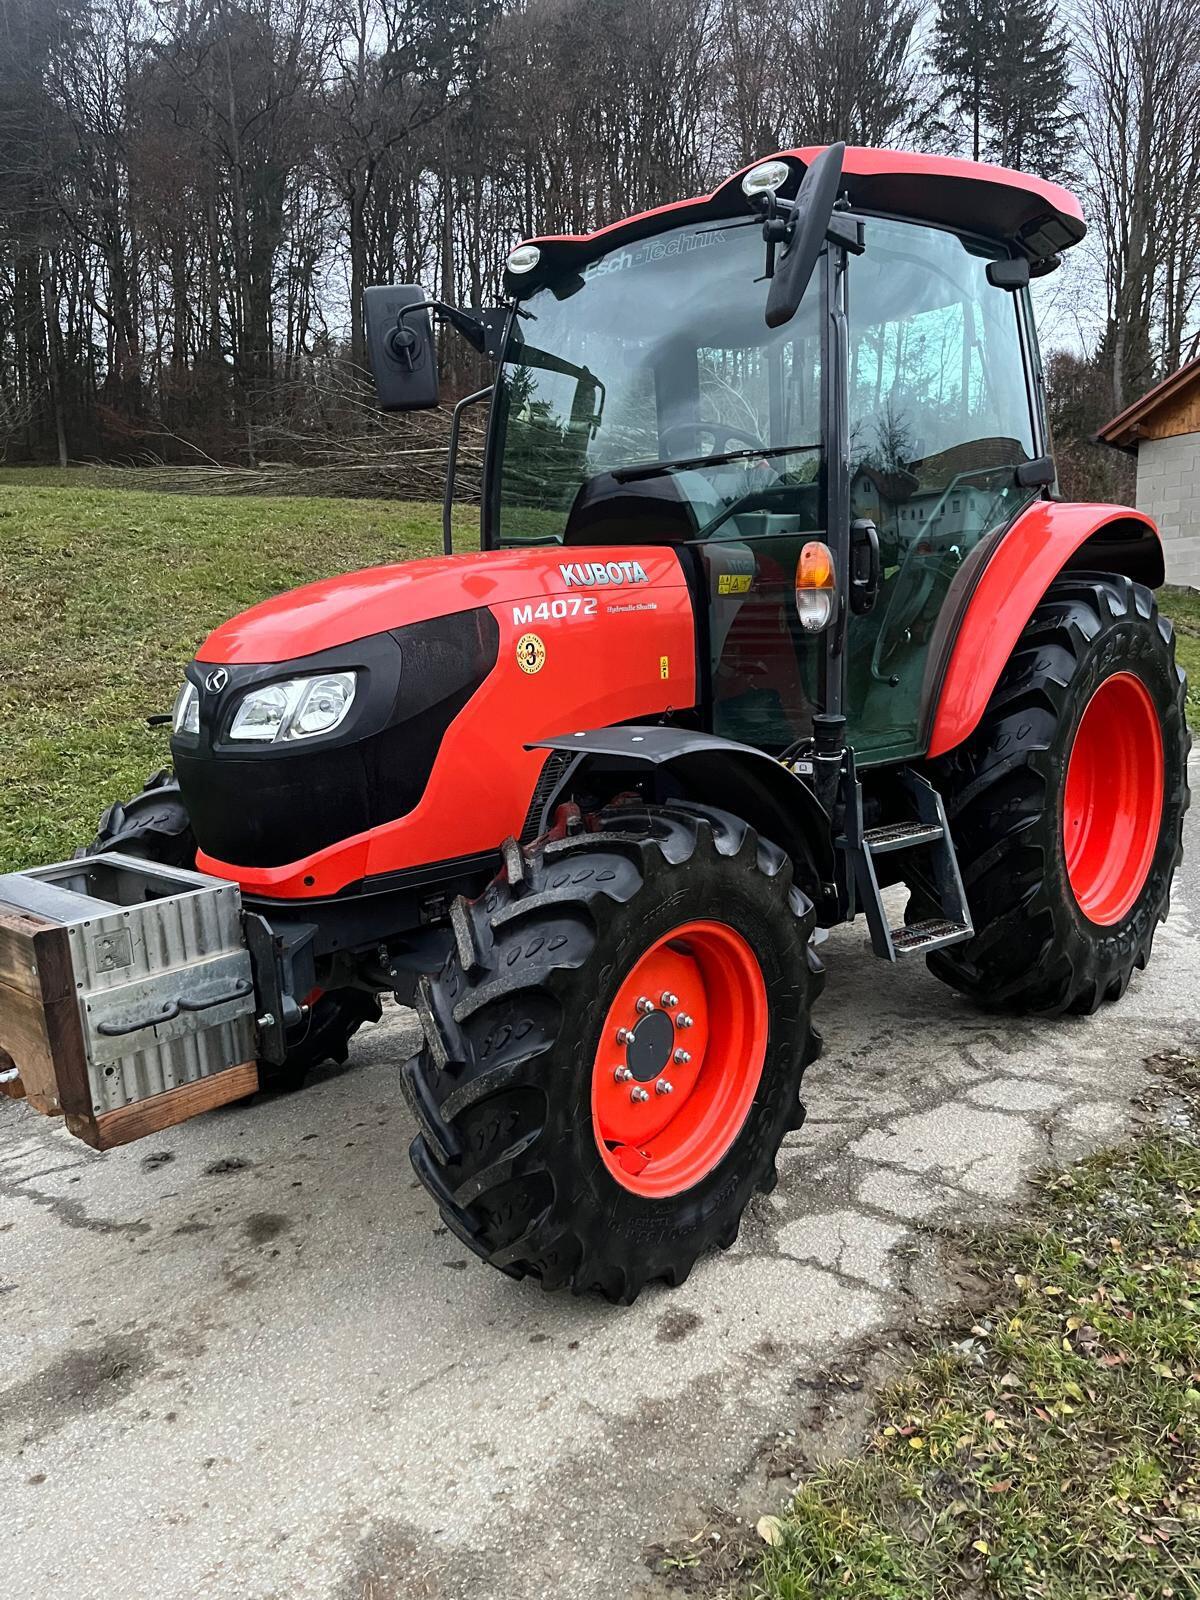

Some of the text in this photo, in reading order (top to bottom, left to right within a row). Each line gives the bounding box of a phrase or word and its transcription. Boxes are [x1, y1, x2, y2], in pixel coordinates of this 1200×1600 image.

[559, 561, 649, 586] KUBOTA
[513, 597, 598, 625] M4072
[525, 643, 536, 666] 3
